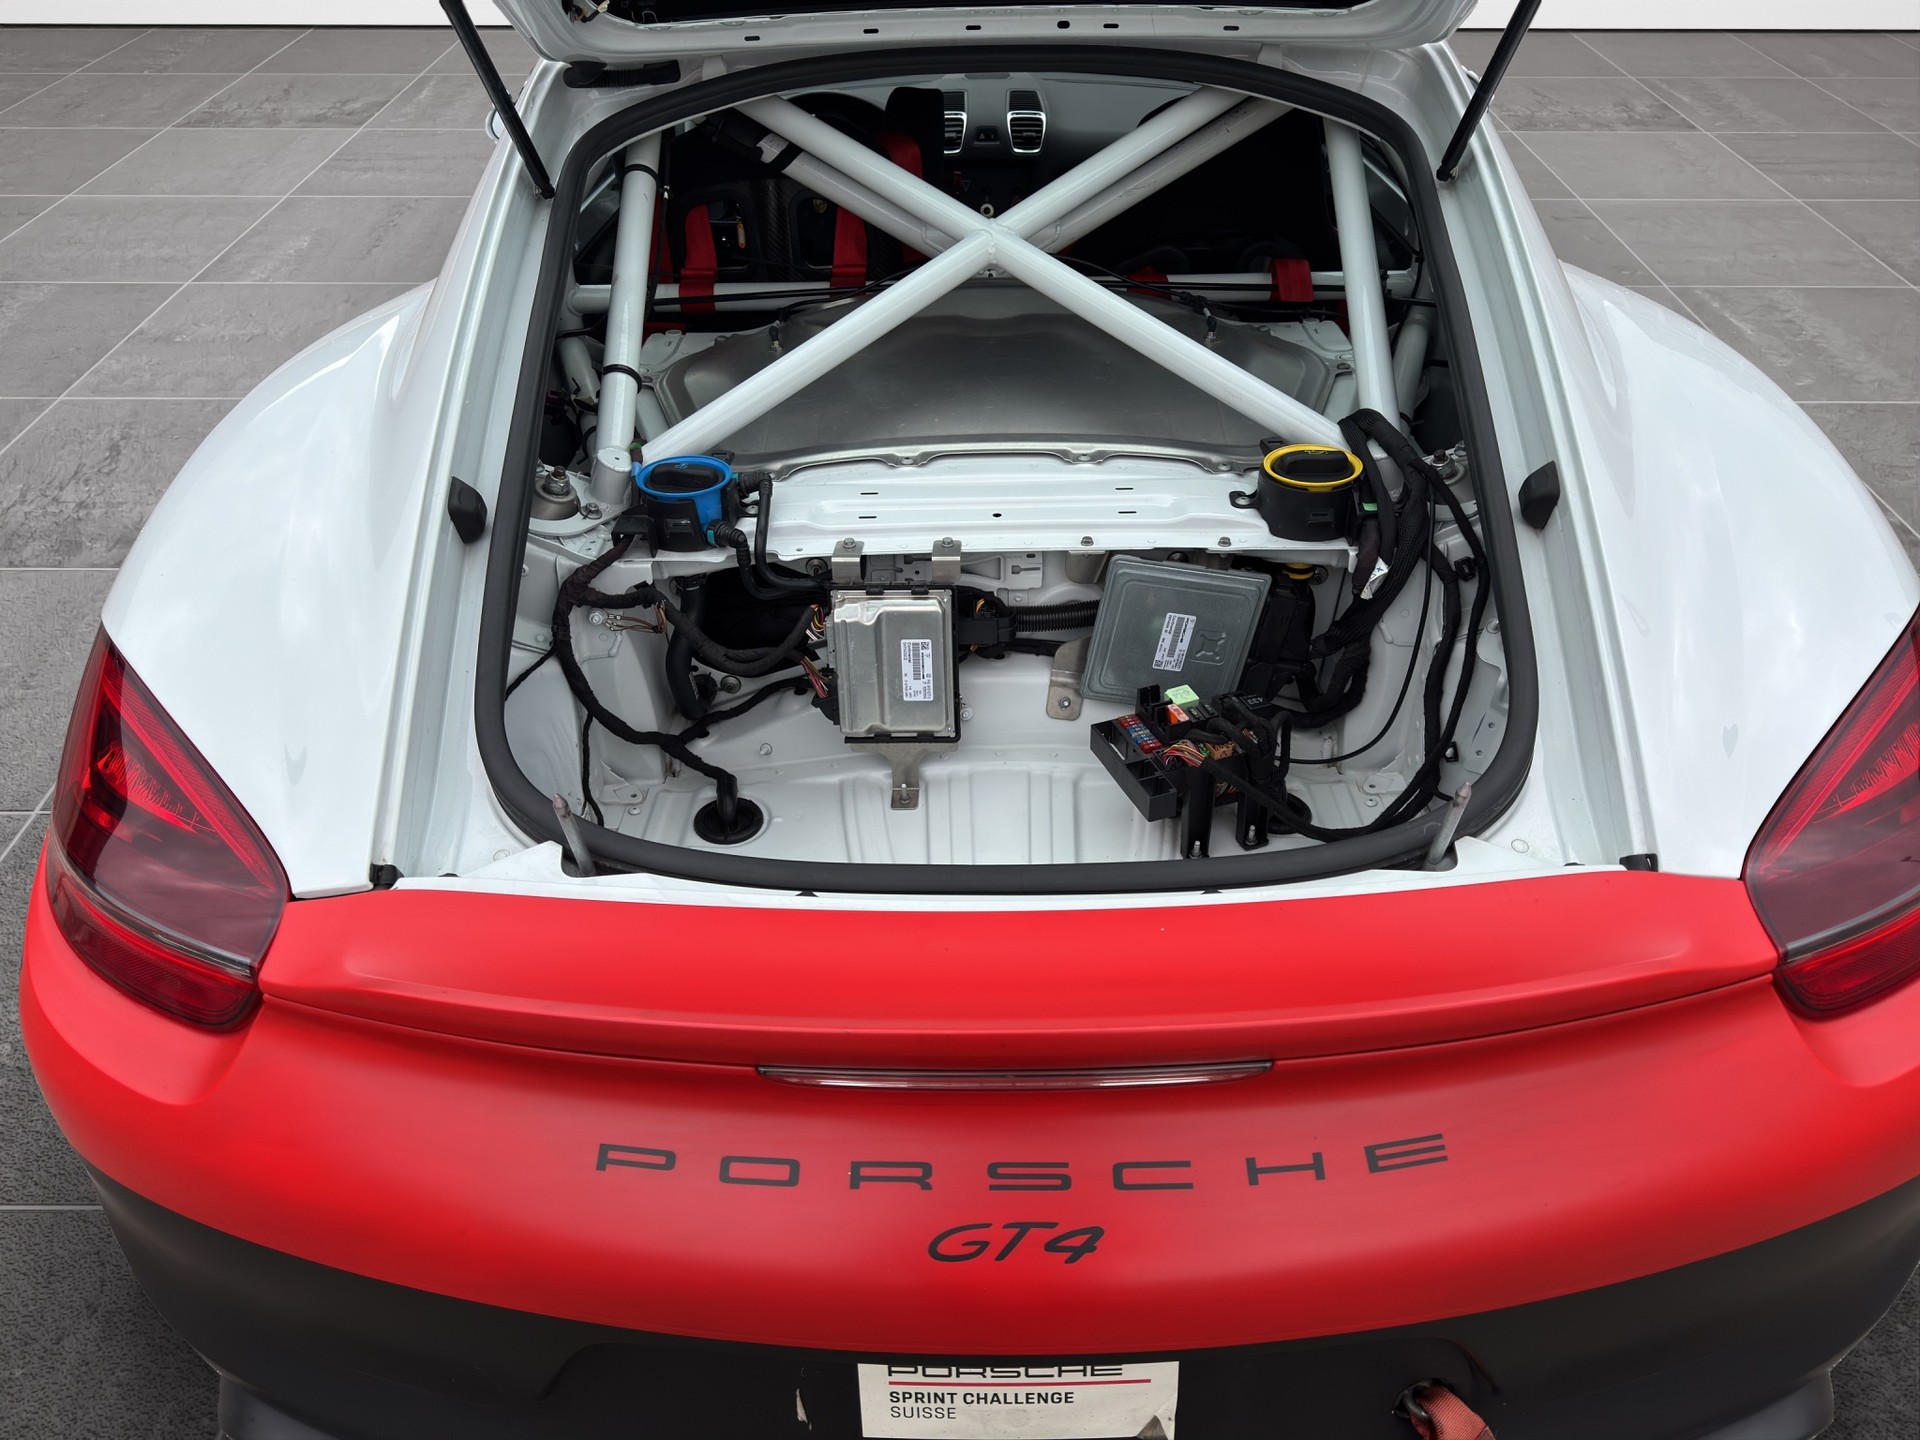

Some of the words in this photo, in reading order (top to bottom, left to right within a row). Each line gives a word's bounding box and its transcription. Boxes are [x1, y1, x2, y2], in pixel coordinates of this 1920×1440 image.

[595, 1133, 1448, 1191] PORSCHE
[928, 1222, 1105, 1264] GT4
[889, 1391, 957, 1404] SPRINT
[963, 1391, 1075, 1405] CHALLENGE
[890, 1406, 957, 1420] SUISSE
